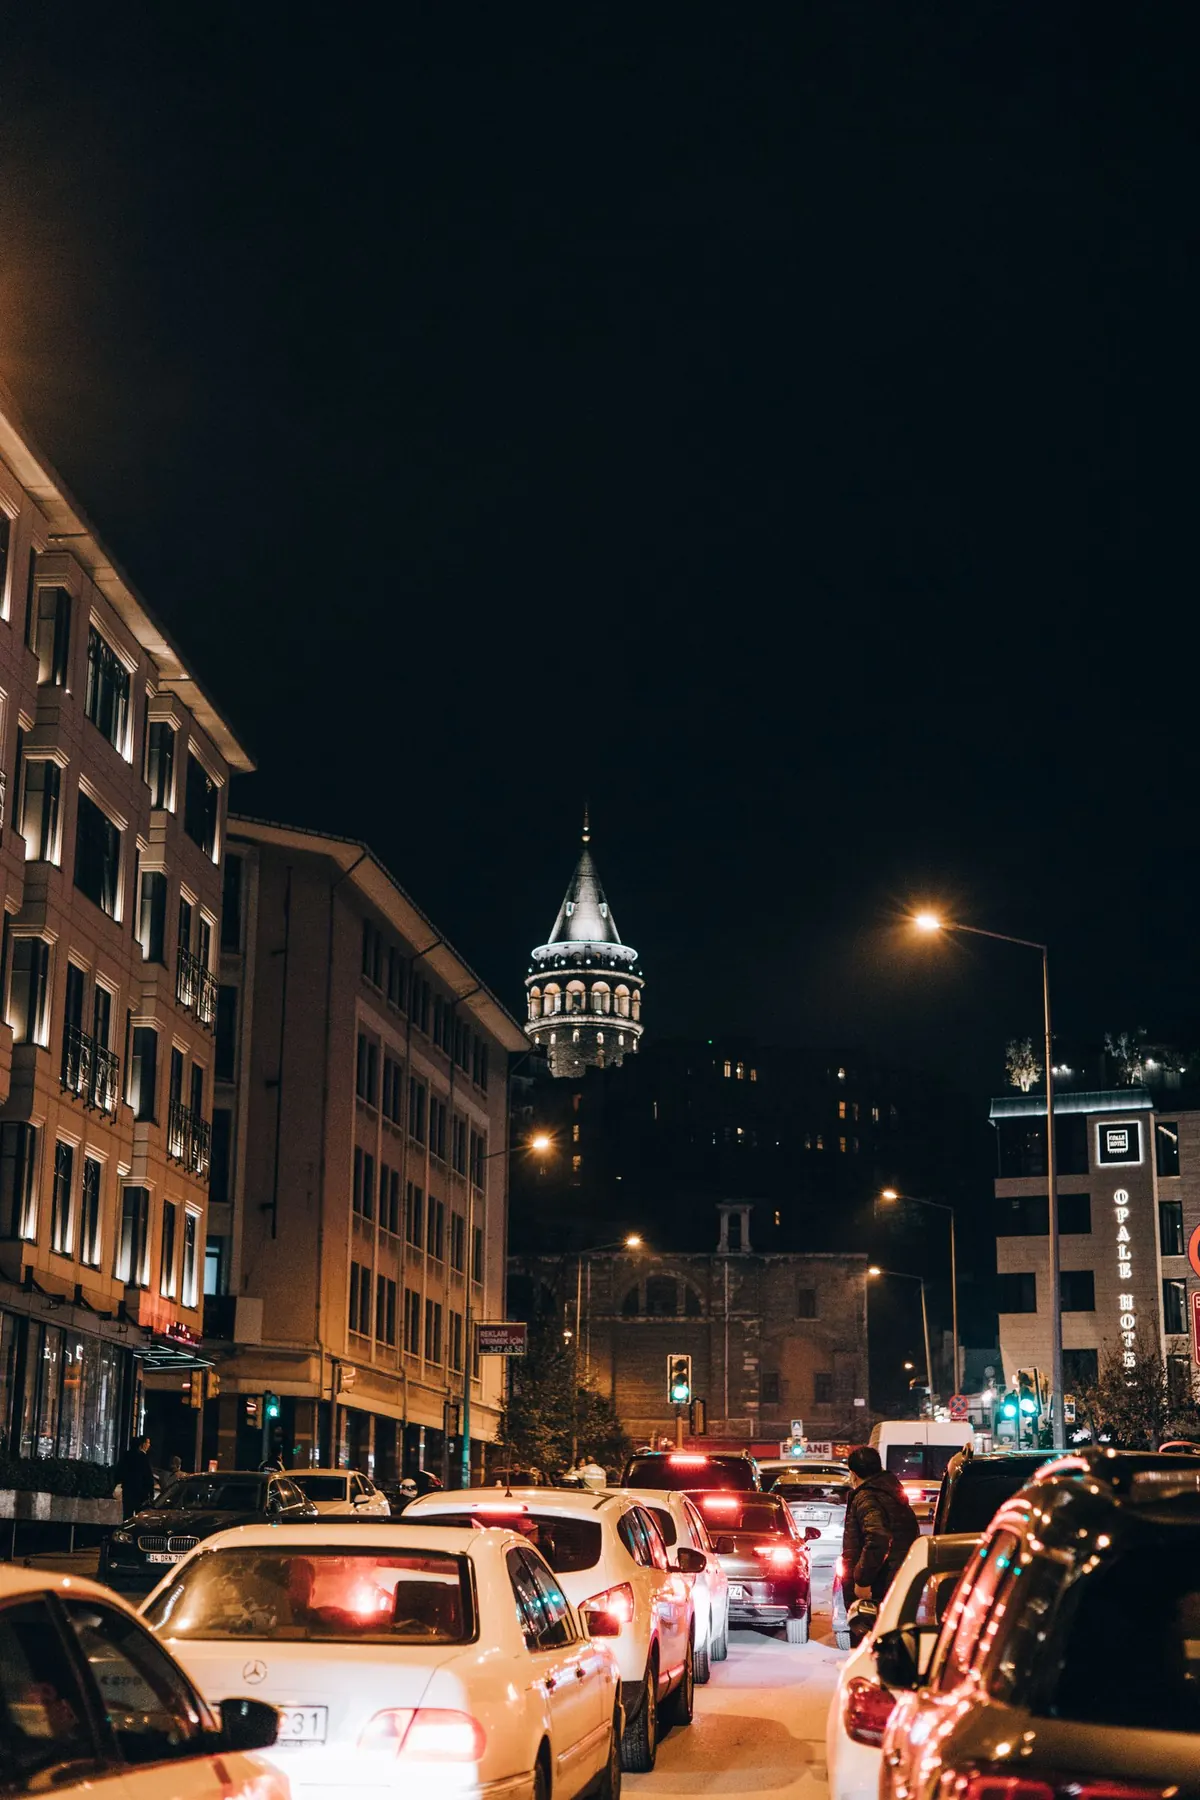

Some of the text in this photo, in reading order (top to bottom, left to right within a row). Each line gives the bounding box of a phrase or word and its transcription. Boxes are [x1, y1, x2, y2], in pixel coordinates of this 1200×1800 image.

[1114, 1189, 1138, 1387] OPALE HOTE
[782, 1444, 830, 1454] EANE
